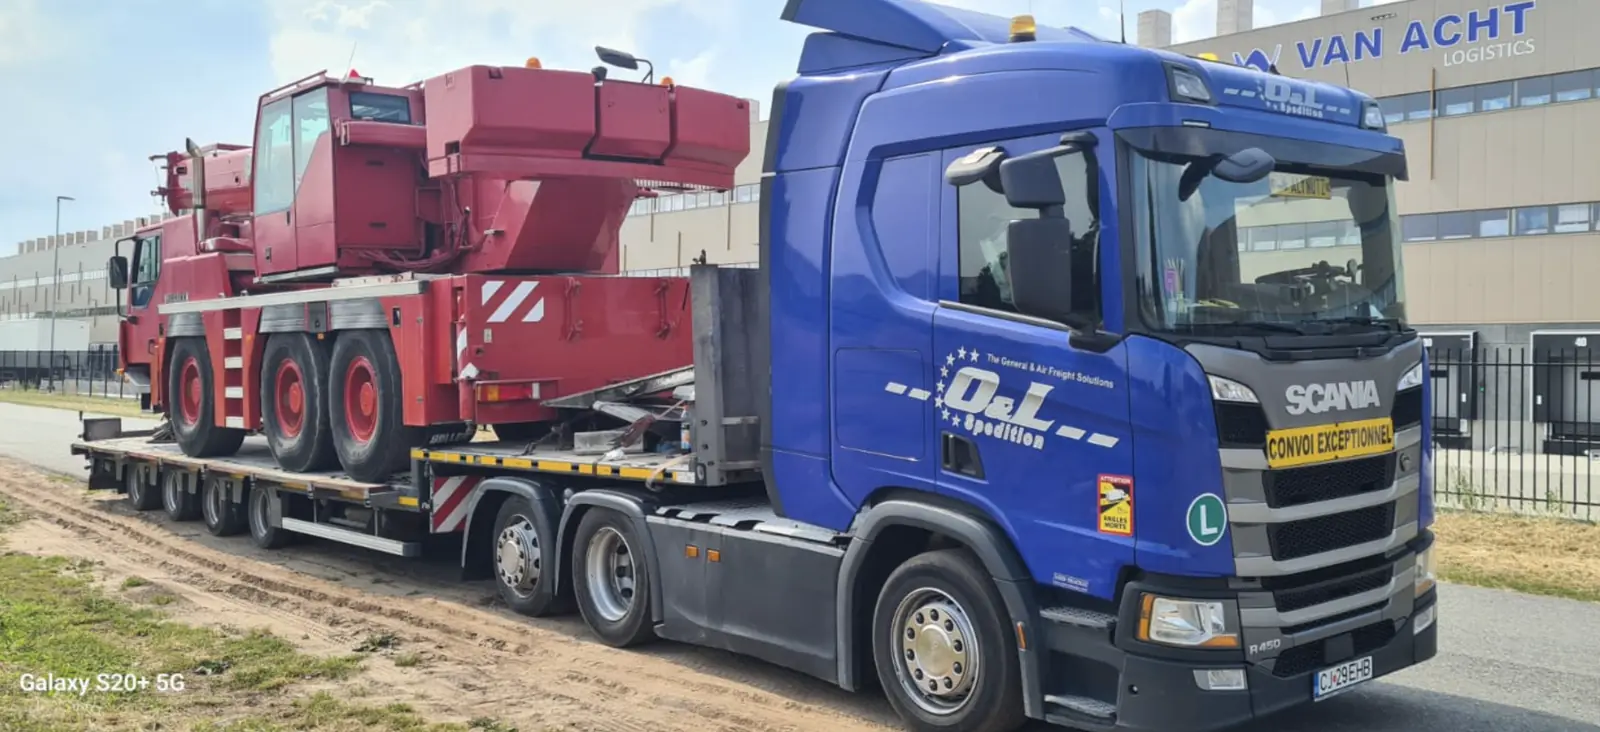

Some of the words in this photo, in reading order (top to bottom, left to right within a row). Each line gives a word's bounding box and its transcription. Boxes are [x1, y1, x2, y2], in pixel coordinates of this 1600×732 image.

[1296, 27, 1383, 69] VAN
[1400, 0, 1536, 53] ACHT
[1443, 38, 1536, 67] LOGISTICS
[987, 353, 999, 364] The
[1001, 356, 1028, 370] General
[1029, 362, 1035, 371] &
[1036, 364, 1046, 374] Air
[1048, 366, 1075, 381] Freight
[1077, 372, 1114, 388] Solutions
[943, 366, 1055, 432] O&L
[1285, 379, 1380, 415] SCANIA
[964, 413, 1045, 450] Spedition
[1269, 433, 1314, 460] CONVOI
[1318, 424, 1392, 453] EXCEPTIONNEL
[1103, 515, 1128, 524] ANGLES
[1104, 522, 1127, 530] MORTS
[1200, 504, 1218, 536] L
[1249, 645, 1258, 655] R
[1259, 638, 1281, 652] 450
